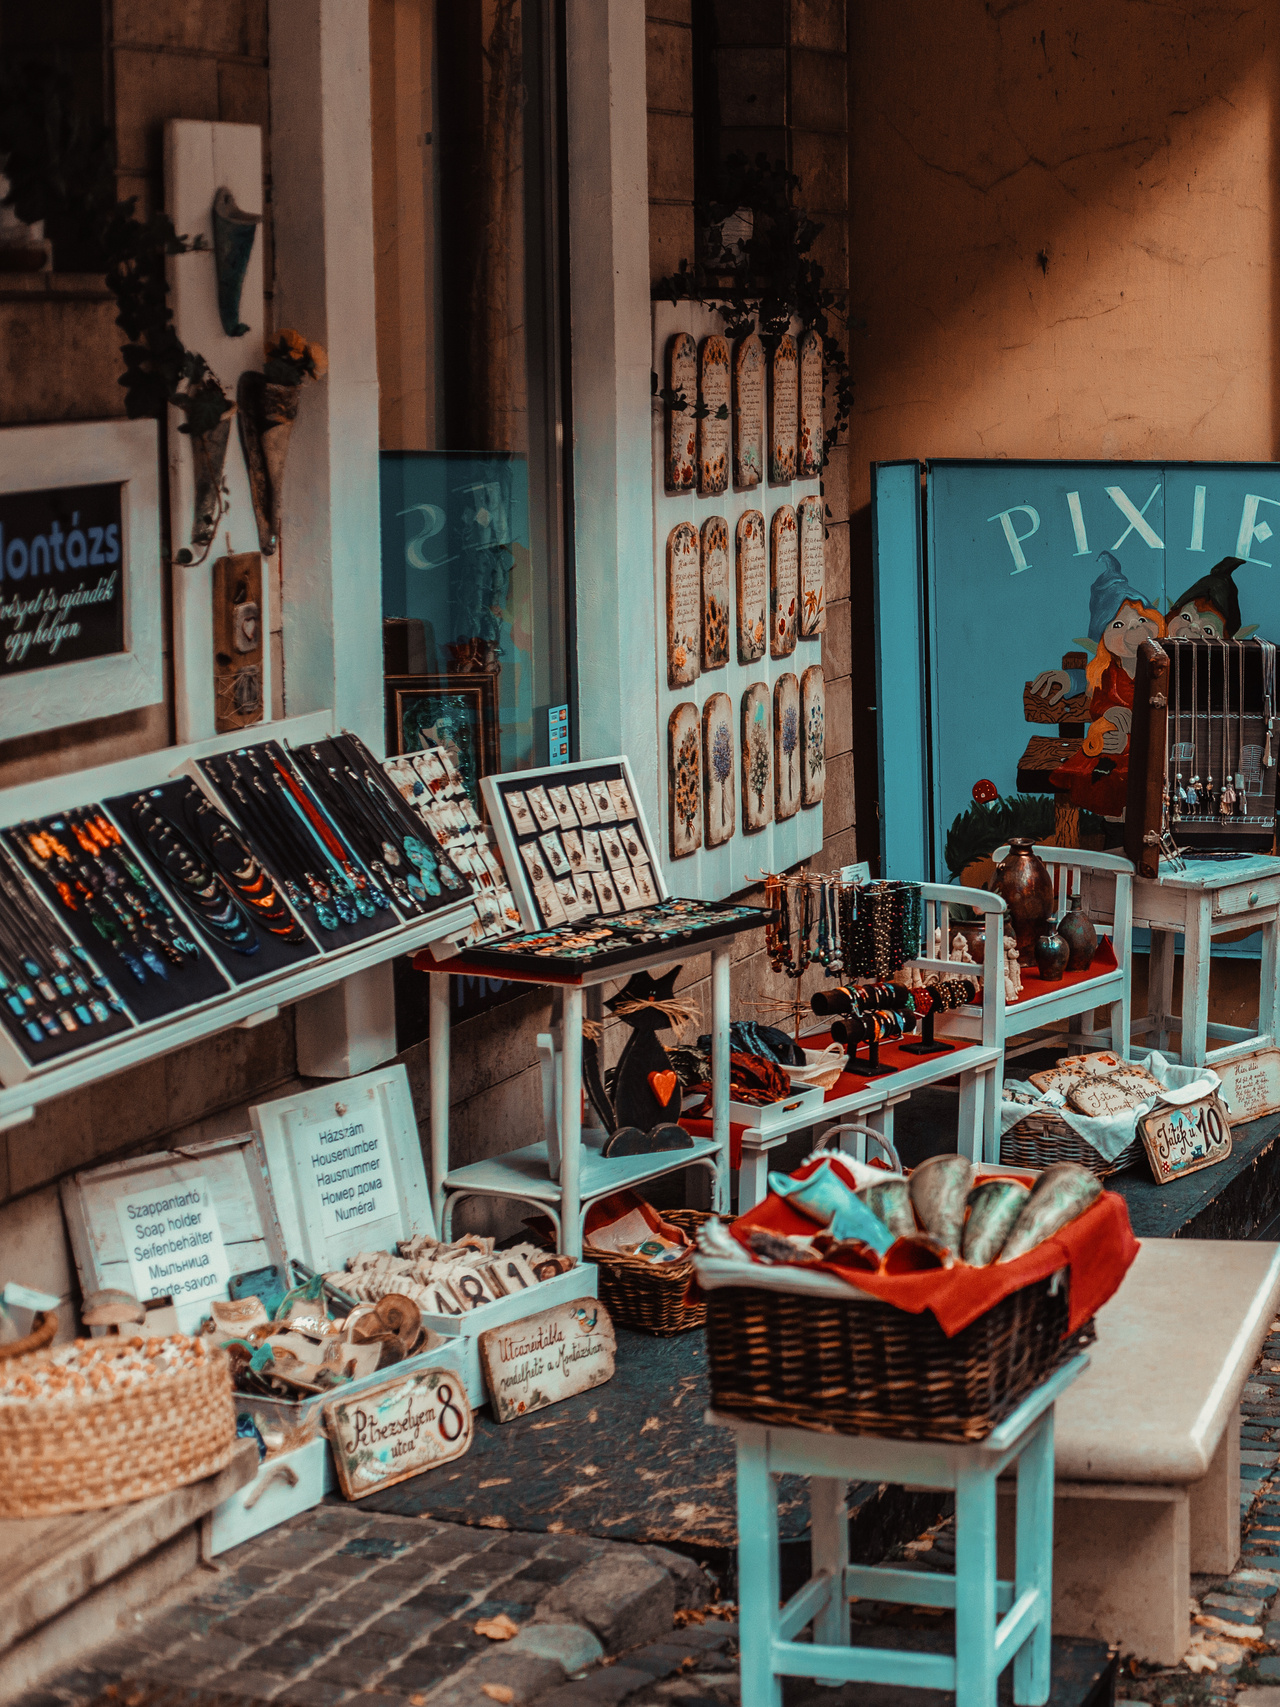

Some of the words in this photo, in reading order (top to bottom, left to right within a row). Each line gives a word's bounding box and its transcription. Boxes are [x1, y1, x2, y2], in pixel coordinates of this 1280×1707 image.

[0, 511, 119, 581] ontázs
[0, 587, 45, 630] vészet
[59, 569, 118, 621] ajándék
[5, 631, 32, 663] egy
[32, 611, 81, 654] helyen
[319, 1123, 365, 1145] Házszám
[1157, 1117, 1193, 1159] Játék
[311, 1139, 378, 1168] Housenumber
[316, 1159, 380, 1187] Hausnummer
[127, 1189, 201, 1219] Szappantartó
[321, 1187, 355, 1206] Номер
[357, 1178, 383, 1196] дома
[335, 1198, 376, 1222] Numéral
[135, 1222, 165, 1239] Soap
[167, 1212, 202, 1232] holder
[134, 1231, 213, 1261] Seifenbehälter
[148, 1254, 210, 1280] Мыльница
[150, 1273, 217, 1298] Porte-savon
[499, 1322, 565, 1363] Utcanévtábla
[501, 1358, 544, 1394] rendelhető
[547, 1363, 554, 1372] a
[345, 1397, 436, 1454] Petrezselyem
[390, 1439, 416, 1458] utca
